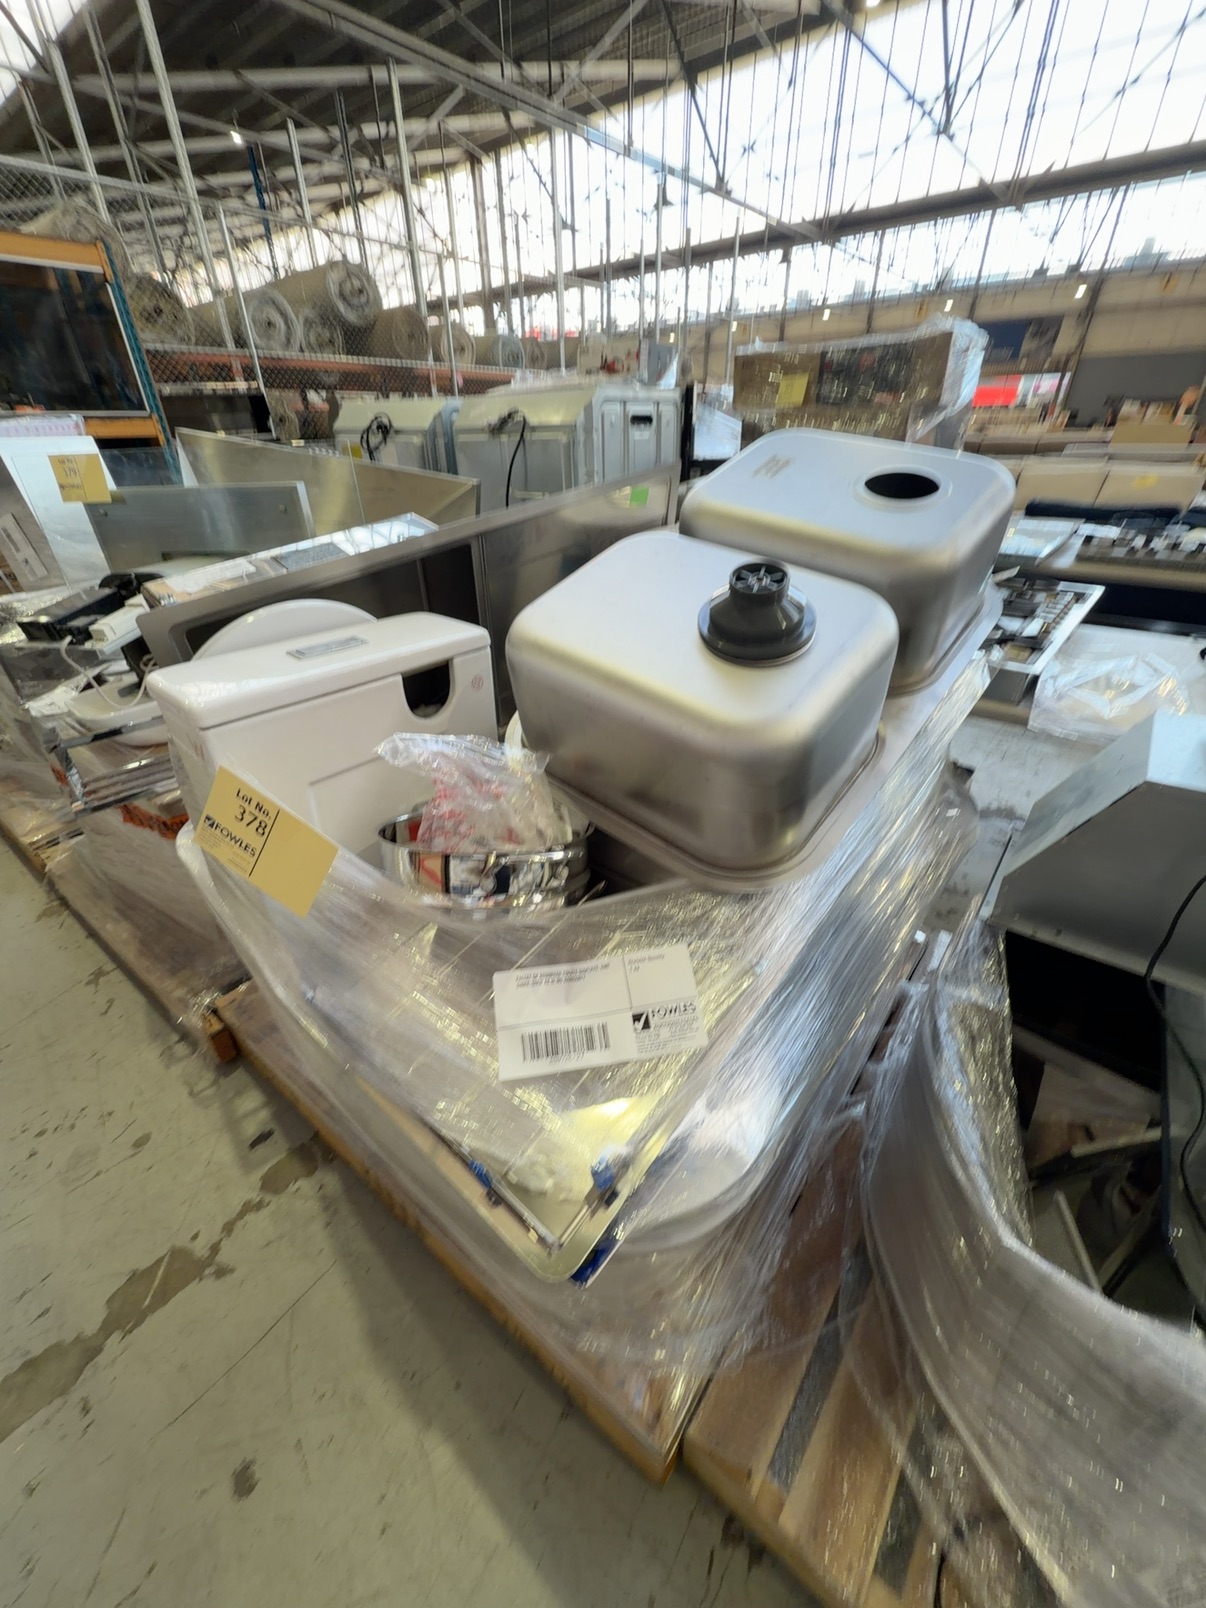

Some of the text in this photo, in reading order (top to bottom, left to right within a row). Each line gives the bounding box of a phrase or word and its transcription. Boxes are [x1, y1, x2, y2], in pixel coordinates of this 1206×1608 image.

[236, 788, 271, 820] Lot No.
[234, 805, 268, 837] 378
[214, 823, 257, 858] FOWLES
[651, 1001, 697, 1020] FOWLES
